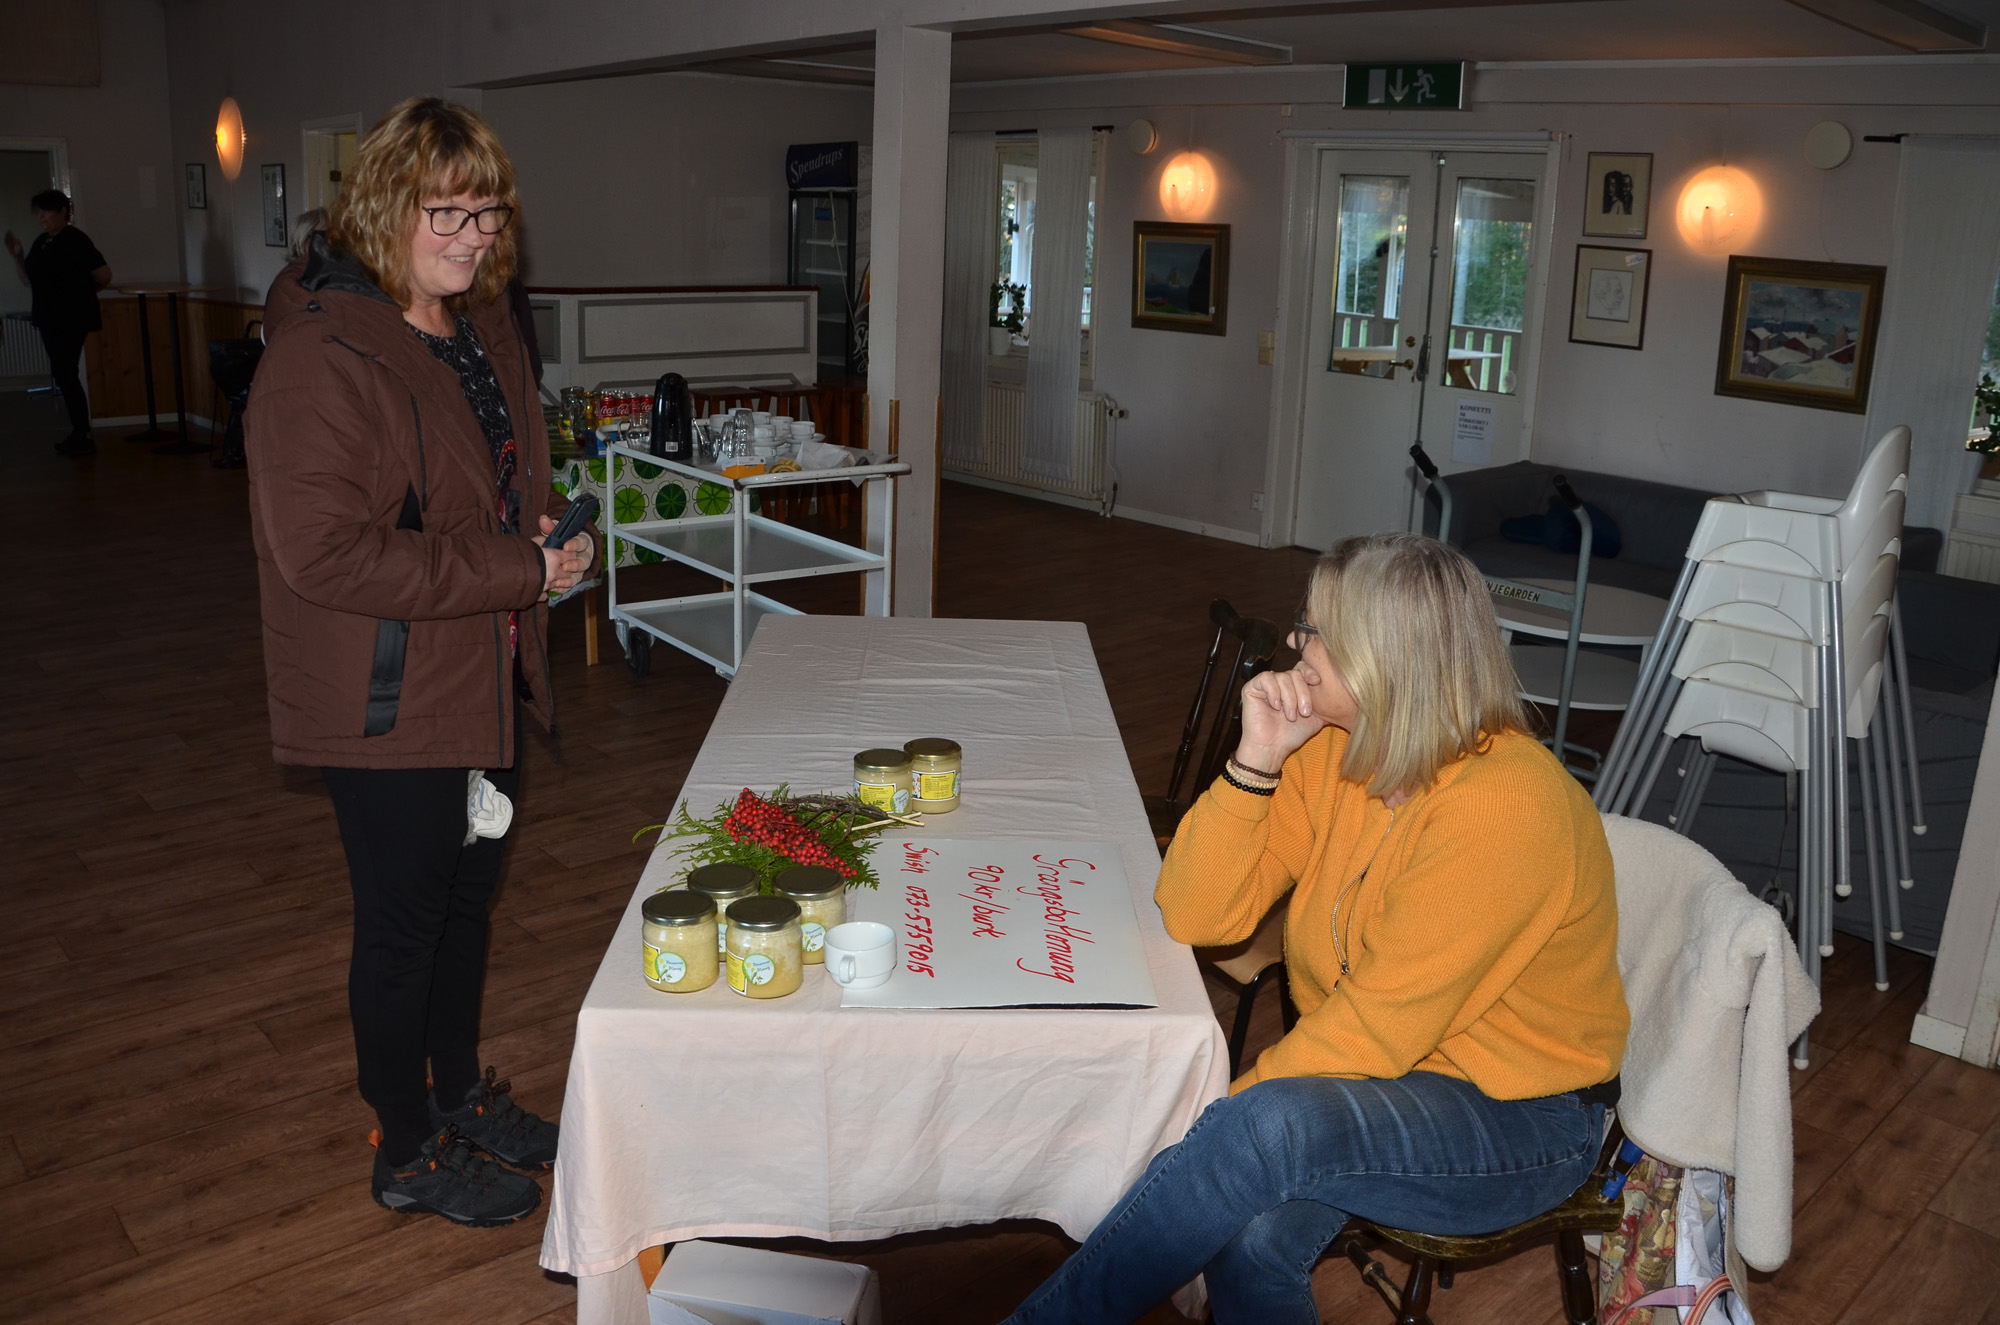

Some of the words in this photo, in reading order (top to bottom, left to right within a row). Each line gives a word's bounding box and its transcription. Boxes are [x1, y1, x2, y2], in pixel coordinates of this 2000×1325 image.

[790, 148, 843, 183] Spendrups
[1460, 405, 1491, 413] KONFETTI
[900, 842, 939, 873] Swish
[905, 885, 935, 978] 073-5759015
